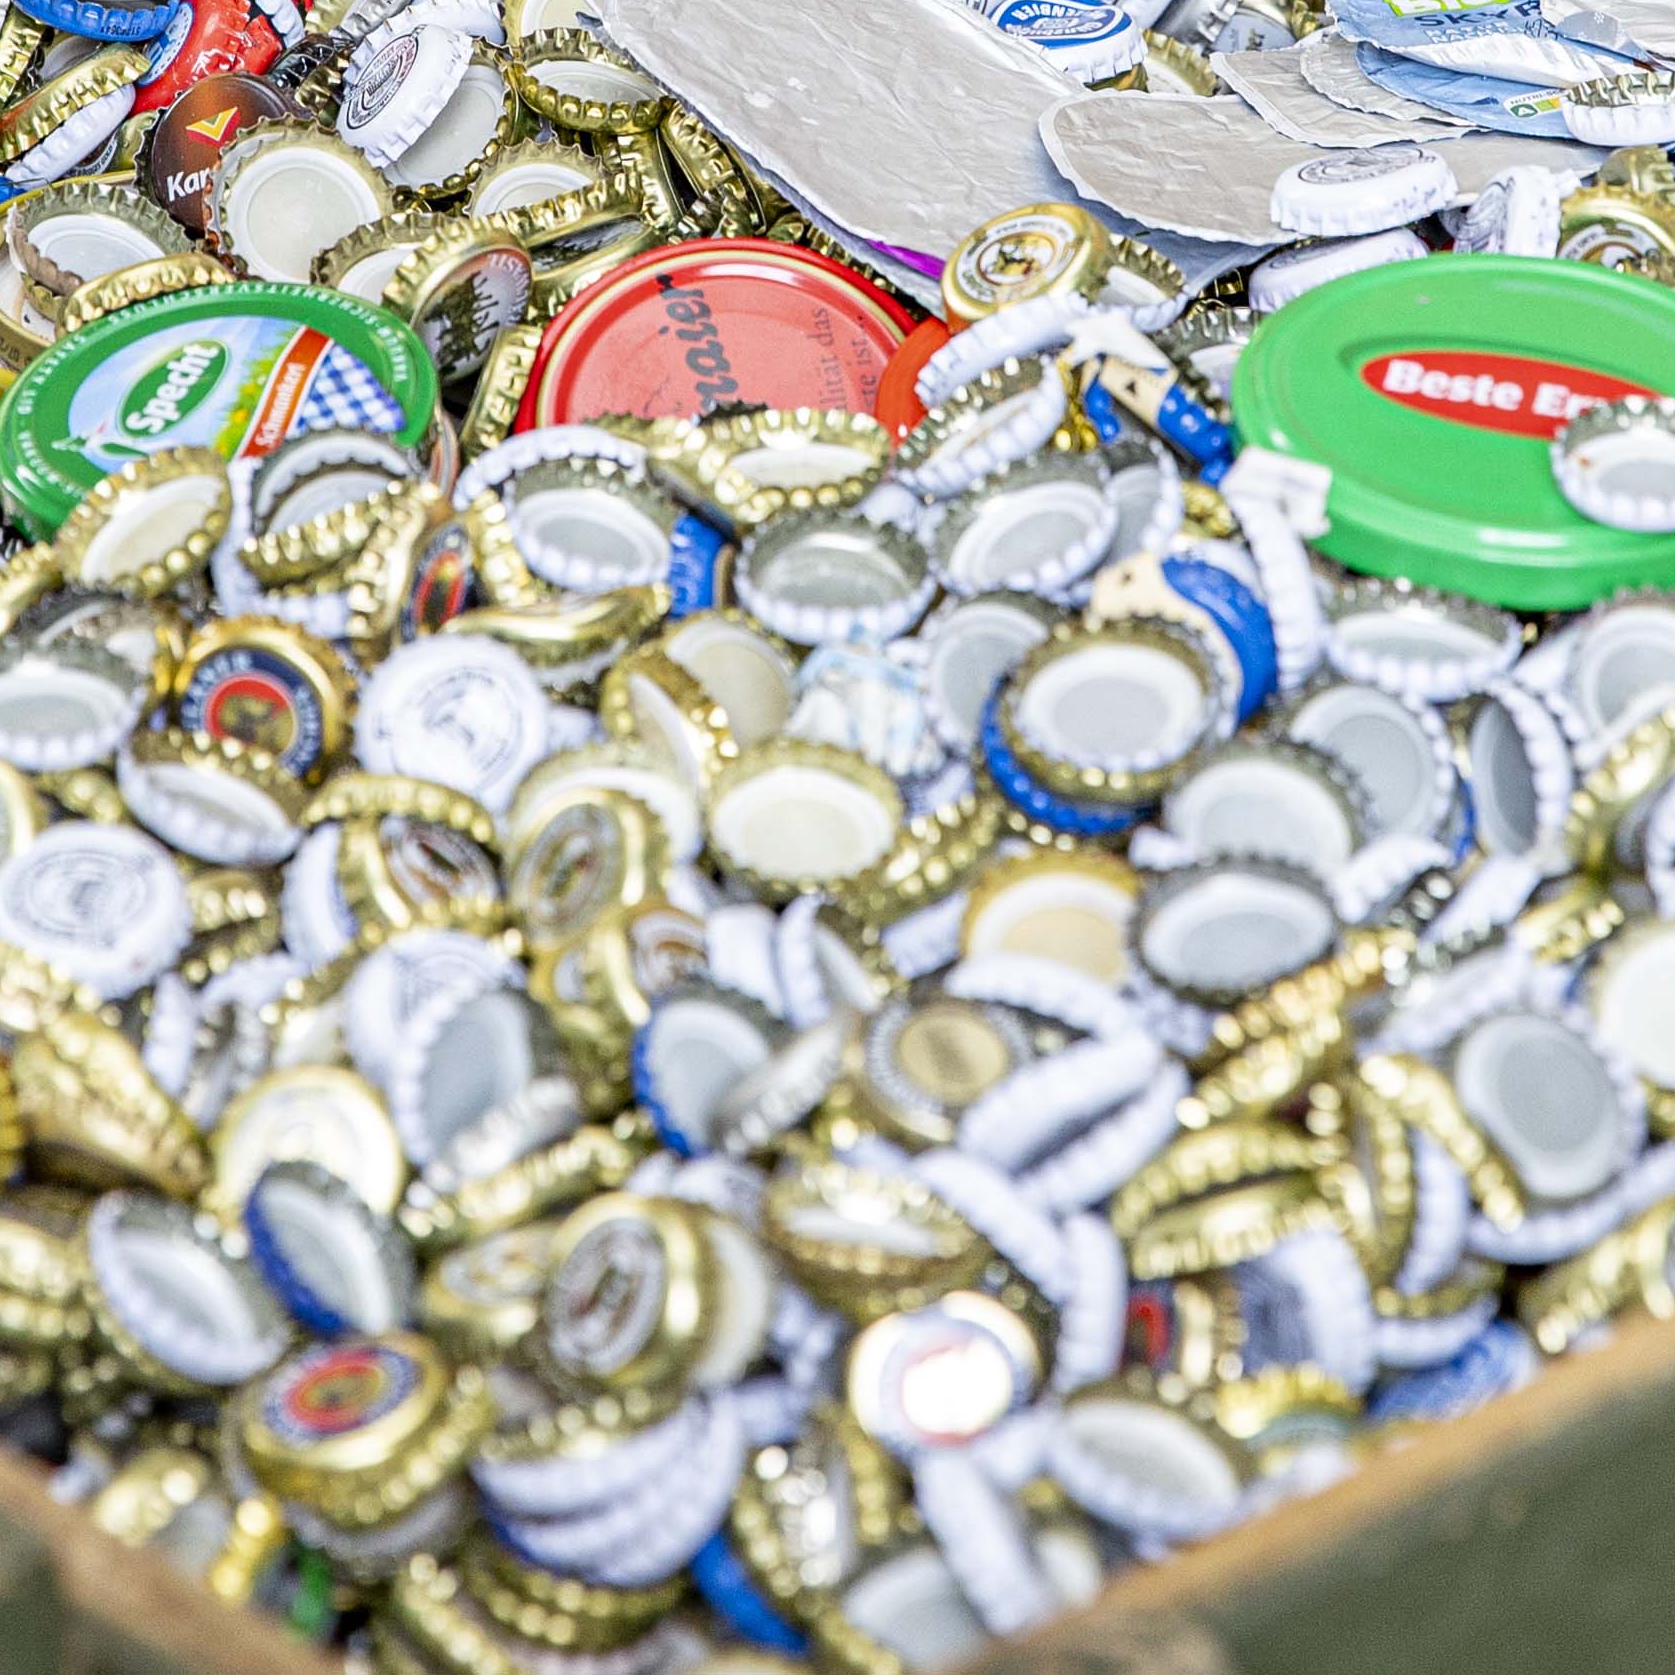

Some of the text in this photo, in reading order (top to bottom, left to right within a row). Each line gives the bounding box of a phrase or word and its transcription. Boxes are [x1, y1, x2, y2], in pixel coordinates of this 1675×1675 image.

[1414, 0, 1541, 26] SKYR
[807, 307, 836, 348] das
[125, 343, 221, 435] Specht
[1382, 358, 1525, 411] Beste
